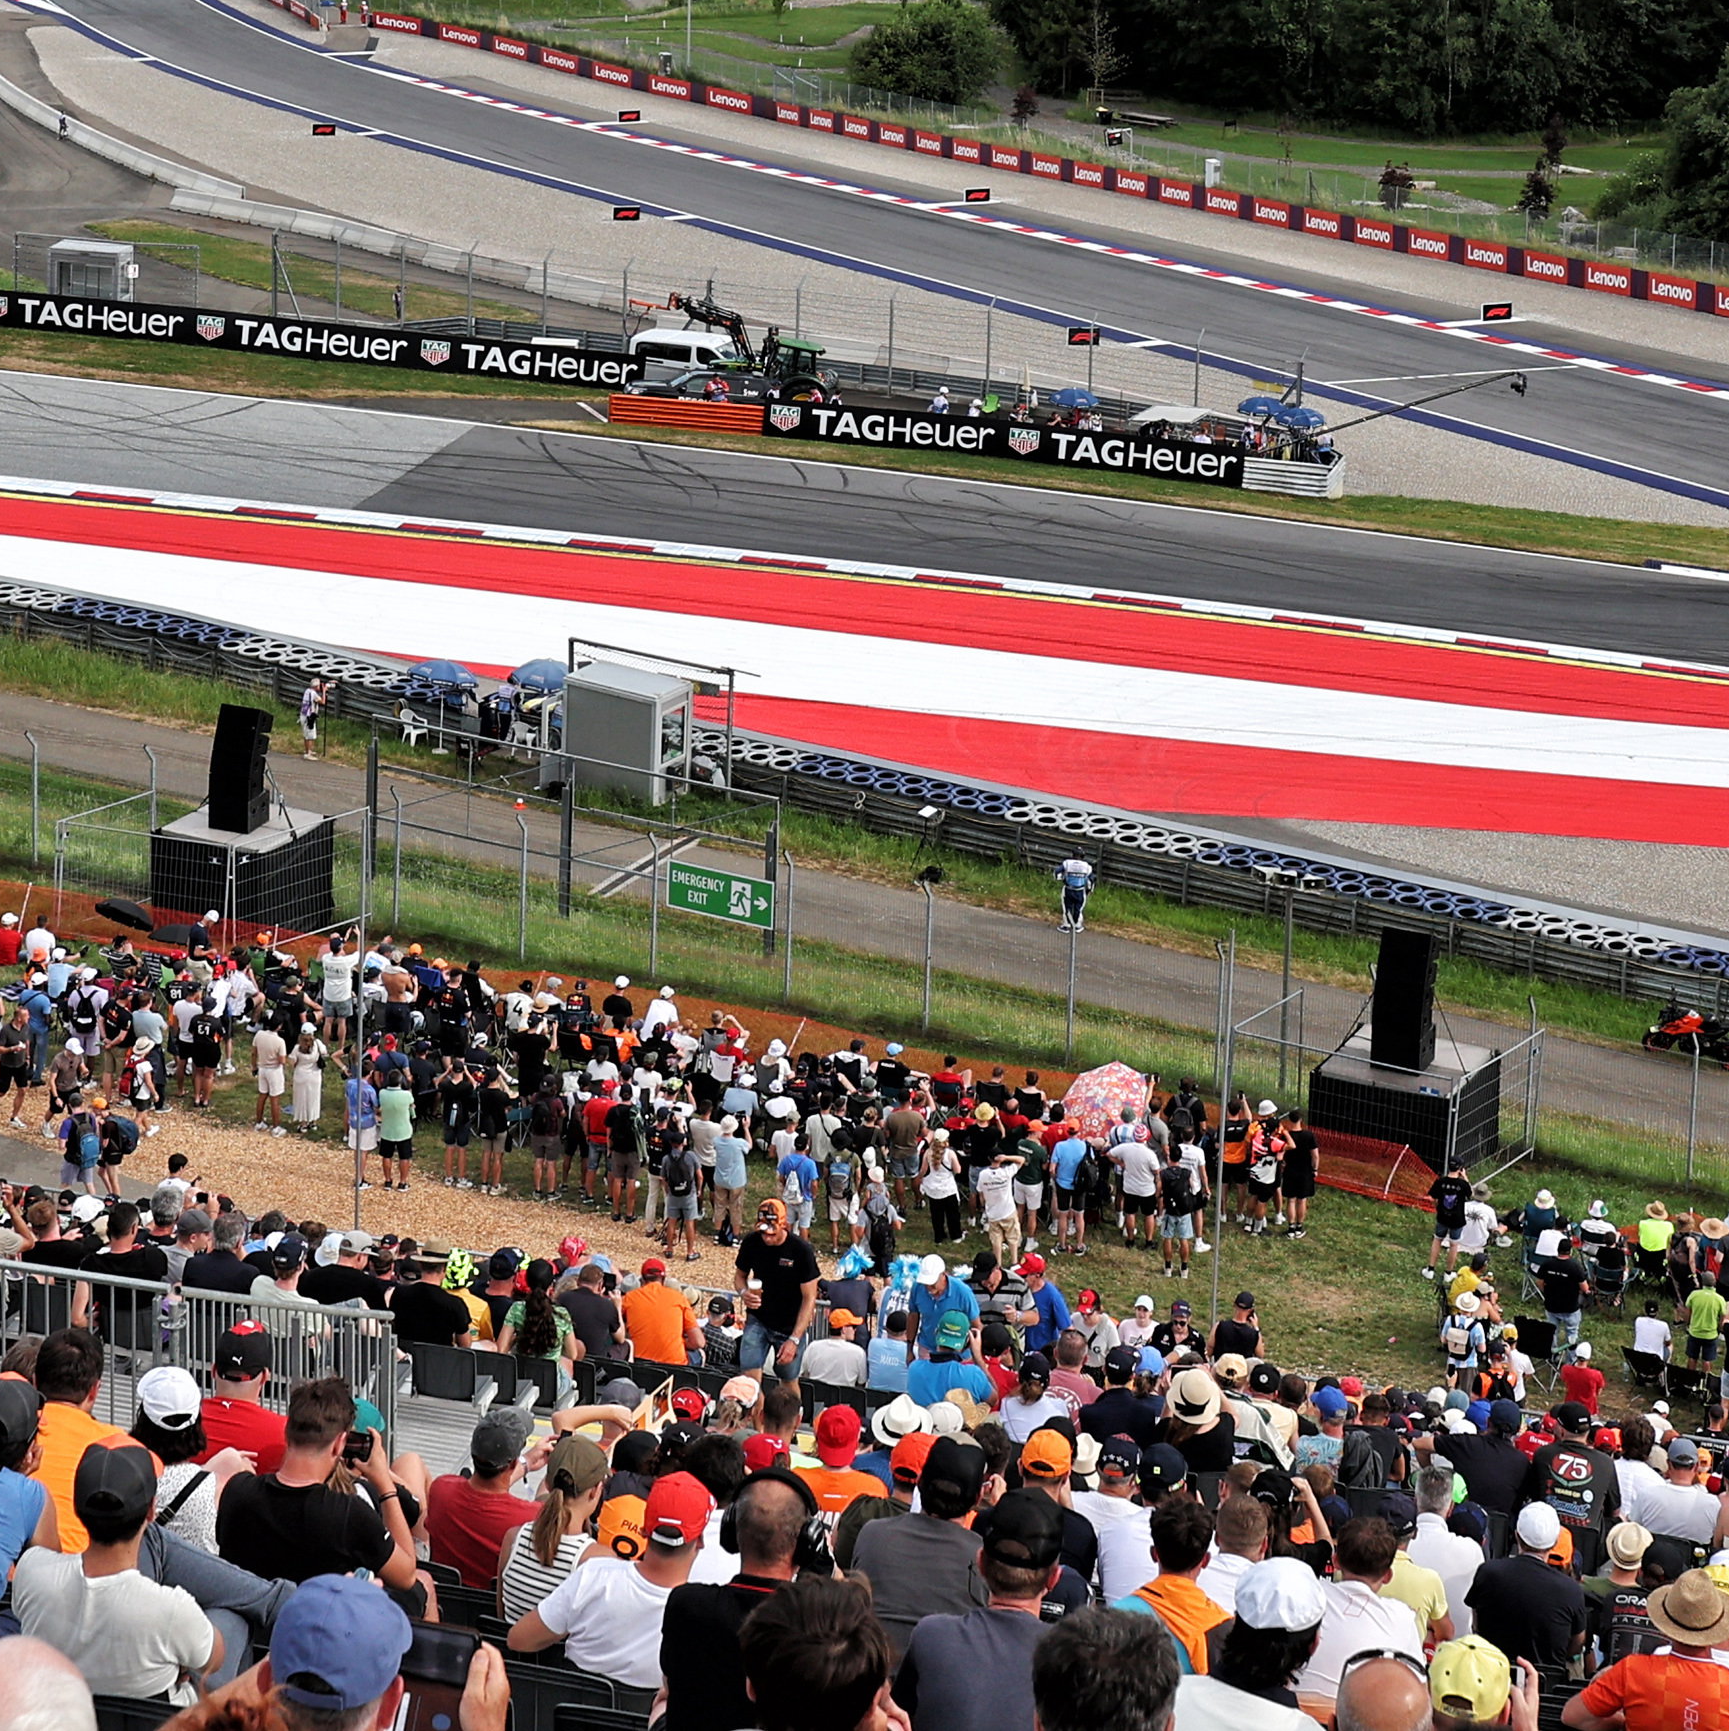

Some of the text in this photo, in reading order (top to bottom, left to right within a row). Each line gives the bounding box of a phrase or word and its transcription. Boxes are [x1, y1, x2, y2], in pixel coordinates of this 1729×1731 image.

[376, 15, 417, 30] Lenovo
[443, 27, 477, 44] Lenovo
[494, 40, 525, 56] Lenovo
[543, 52, 575, 69] Lenovo
[595, 66, 628, 83] Lenovo
[652, 79, 687, 95] Lenovo
[710, 91, 748, 109] Lenovo
[845, 119, 868, 135] Lenovo
[881, 127, 904, 143] Lenovo
[917, 135, 940, 151] Lenovo
[954, 142, 978, 158] Lenovo
[993, 150, 1018, 166] Lenovo
[1033, 158, 1059, 174] Lenovo
[1118, 171, 1145, 192] Lenovo
[1161, 183, 1190, 201] Lenovo
[1207, 193, 1237, 211] Lenovo
[1256, 203, 1287, 222] Lenovo
[1306, 213, 1337, 233] Lenovo
[1357, 223, 1390, 243] Lenovo
[1411, 234, 1446, 254] Lenovo
[1468, 244, 1504, 265] Lenovo
[1527, 256, 1564, 277] Lenovo
[1588, 267, 1627, 288] Lenovo
[1652, 279, 1692, 301] Lenovo
[197, 316, 225, 327] TAG
[421, 340, 450, 352] TAG
[771, 406, 801, 419] TAG
[1010, 428, 1040, 441] TAG
[672, 870, 725, 893] EMERGENCY
[688, 890, 708, 905] EXIT
[513, 1001, 523, 1013] 4
[1557, 1453, 1589, 1479] 75
[1615, 1594, 1648, 1604] ORA
